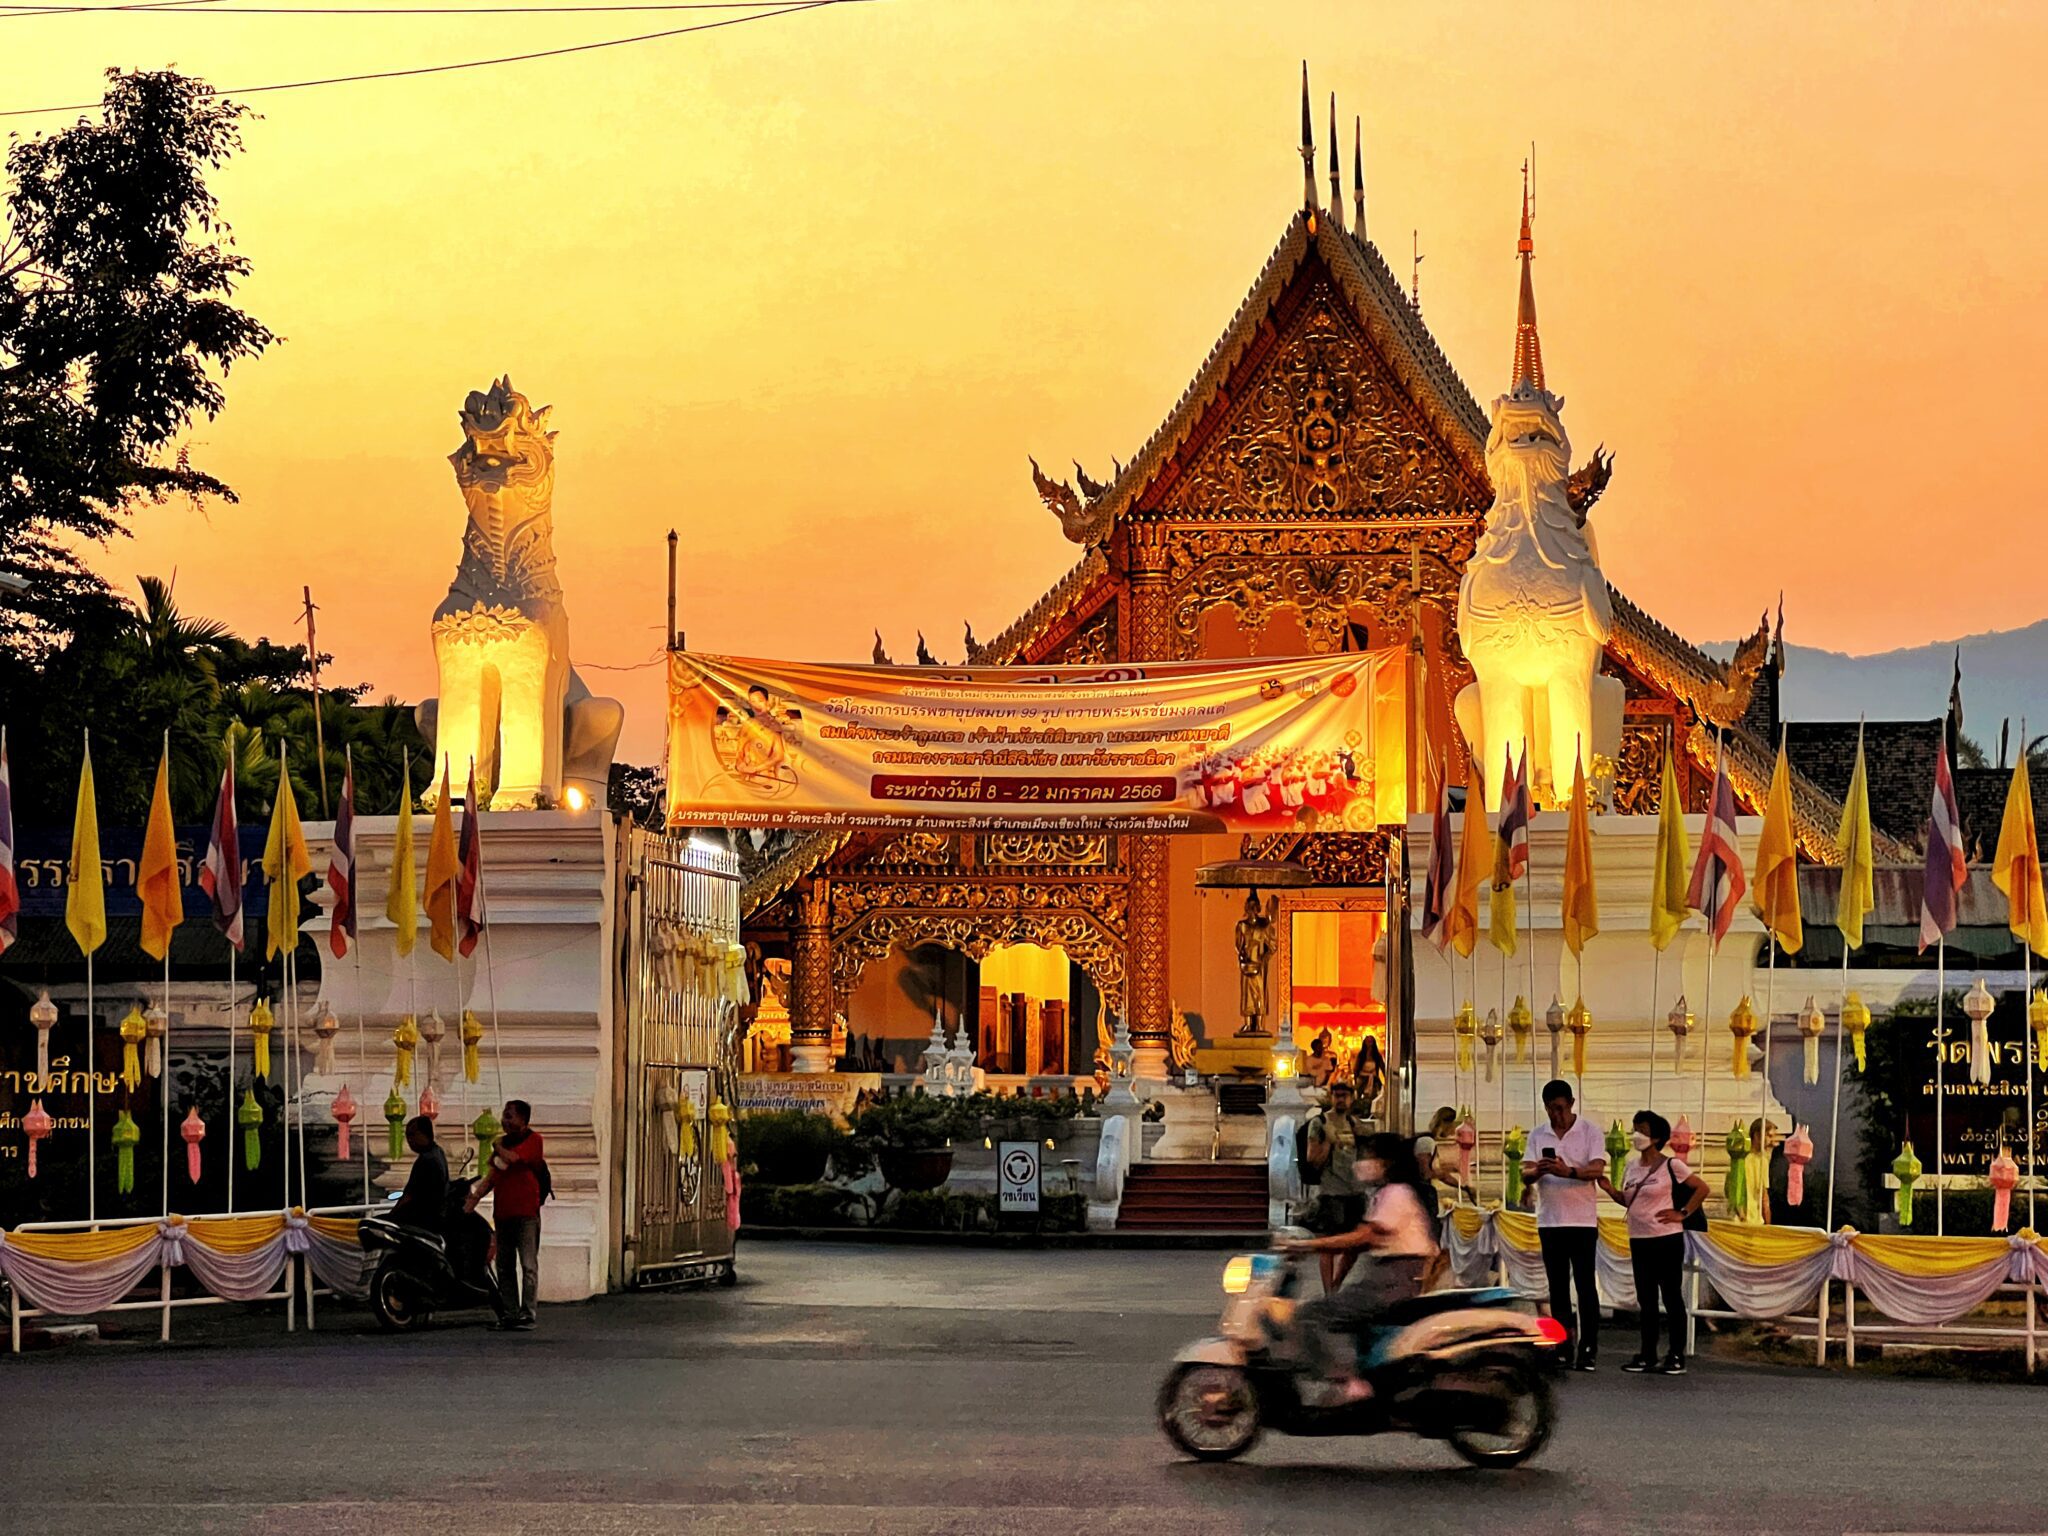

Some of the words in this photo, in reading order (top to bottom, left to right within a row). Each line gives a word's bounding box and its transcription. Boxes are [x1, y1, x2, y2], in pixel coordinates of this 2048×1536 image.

[824, 698, 1016, 722] จัดโครงการบรรพชาอุปสมบท
[1021, 708, 1037, 718] 99
[1041, 708, 1060, 723] รูป
[1066, 702, 1227, 718] ถวายพระพรชัยมงคลแด่
[820, 721, 964, 747] สมเด็จพระเจ้าลูกเธอ
[1060, 748, 1176, 766] มหาวัชรราชธิดา
[884, 776, 982, 799] ระหว่างวันที่
[987, 785, 997, 799] 8
[1019, 785, 1039, 800] 22
[1045, 786, 1115, 800] มกราคม
[1119, 785, 1163, 799] 2566
[678, 810, 768, 825] บรรพชาอุปสมบท
[772, 814, 782, 822] ณ
[787, 810, 847, 825] วัดพระสิงห์
[848, 813, 912, 827] วรมหาวิหาร
[915, 815, 992, 829] ตำบลพระสิงห์
[993, 815, 1102, 830] อำเภอเมืองเชียงใหม่
[1104, 814, 1190, 829] จังหวัดเชียงใหม่
[1943, 1153, 1974, 1165] WAT
[1002, 1186, 1037, 1202] วงเวียน
